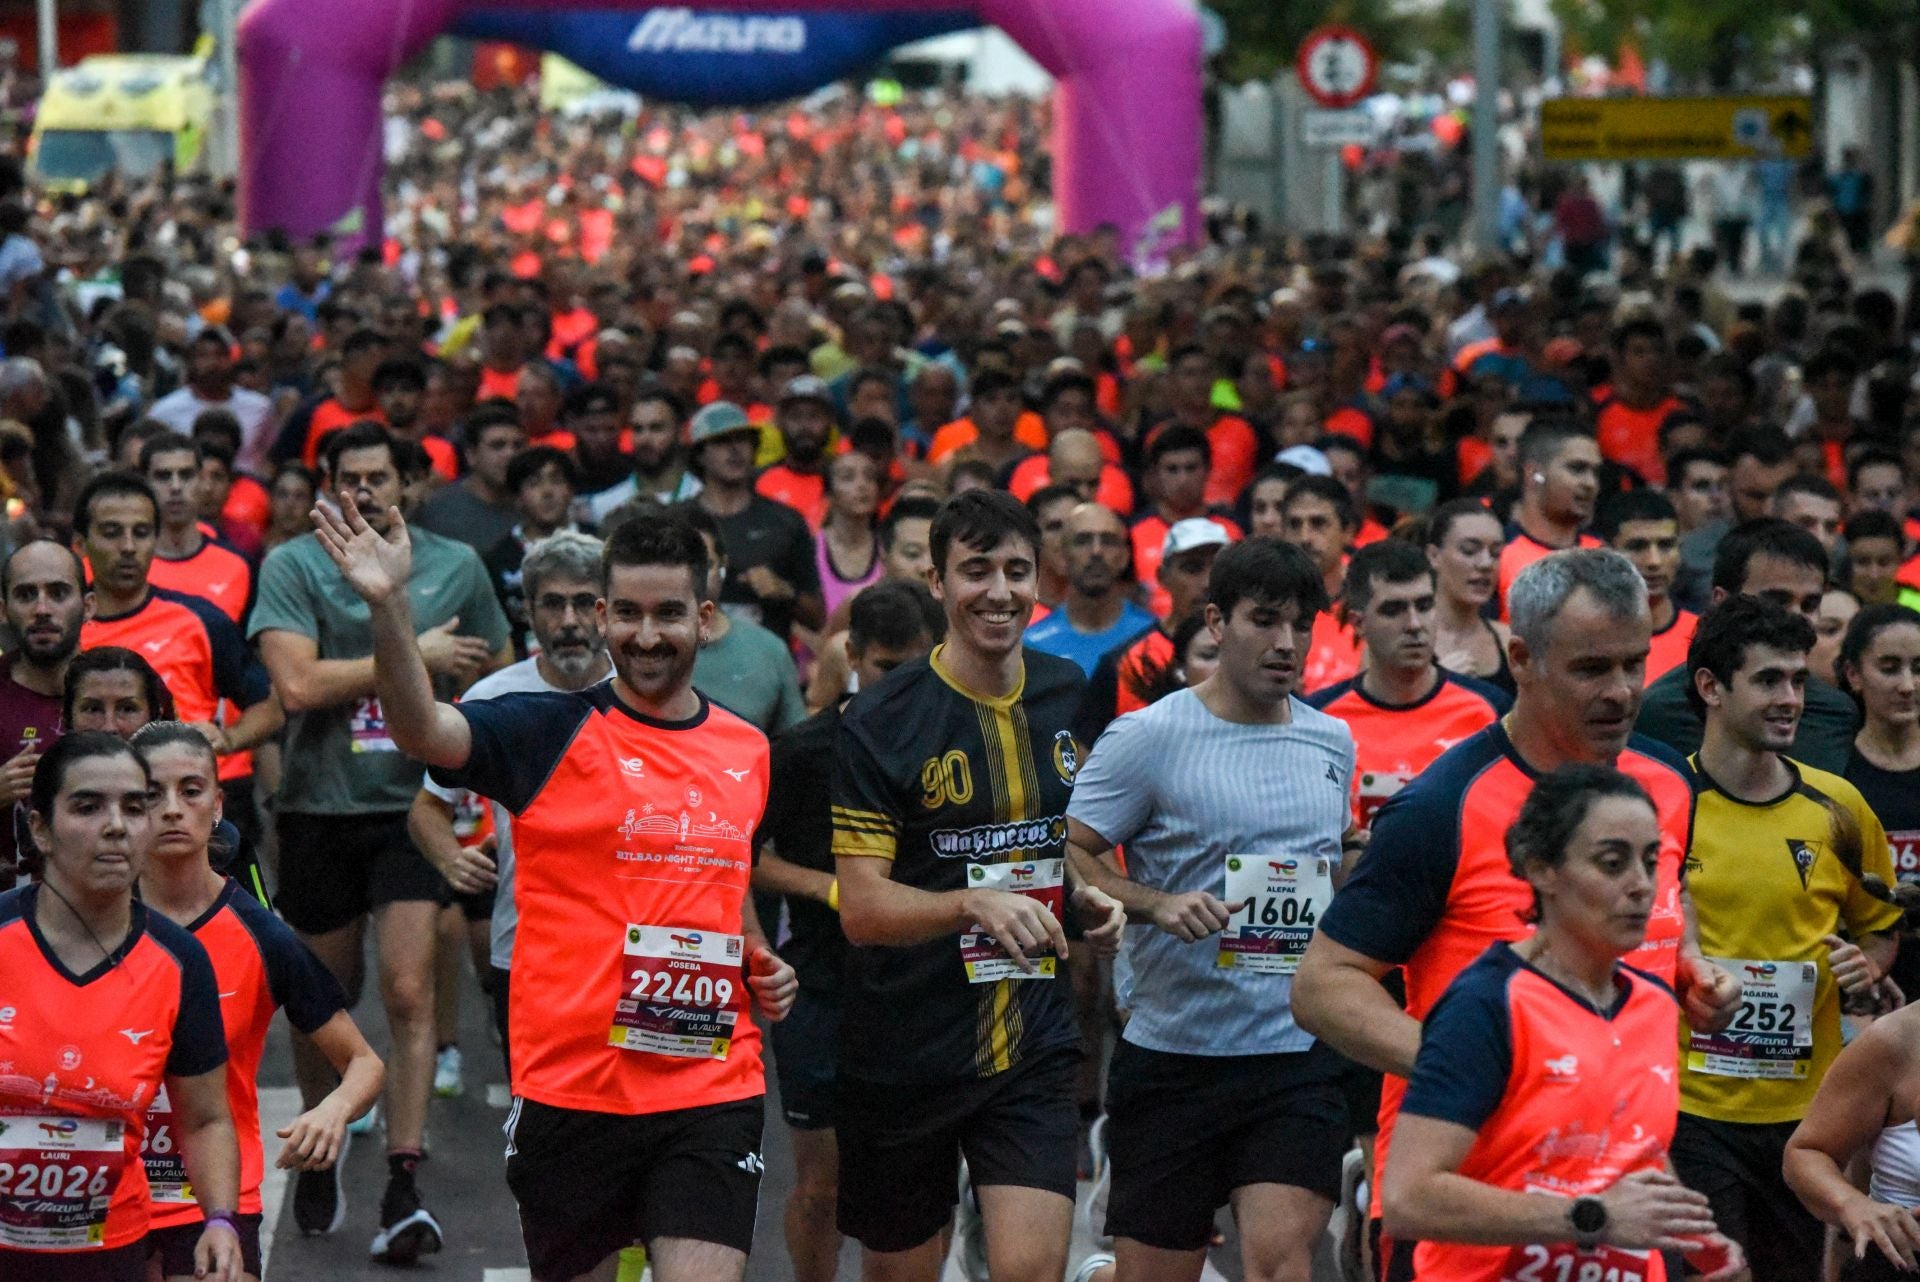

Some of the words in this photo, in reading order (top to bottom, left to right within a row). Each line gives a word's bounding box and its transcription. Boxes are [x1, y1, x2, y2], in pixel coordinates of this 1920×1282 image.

[921, 750, 974, 809] 90
[616, 851, 662, 863] BILBAO
[664, 854, 695, 865] NIGHT
[697, 857, 733, 869] RUNNING
[1266, 886, 1297, 894] ALEPAE
[1244, 896, 1316, 927] 1604
[667, 960, 702, 971] JOSEBA
[1044, 963, 1051, 972] 4
[630, 969, 733, 1009] 22409
[1734, 1001, 1796, 1032] 252
[687, 1022, 698, 1031] LA
[1765, 1047, 1776, 1055] LA
[40, 1151, 71, 1160] LAURI
[0, 1162, 109, 1198] 22026
